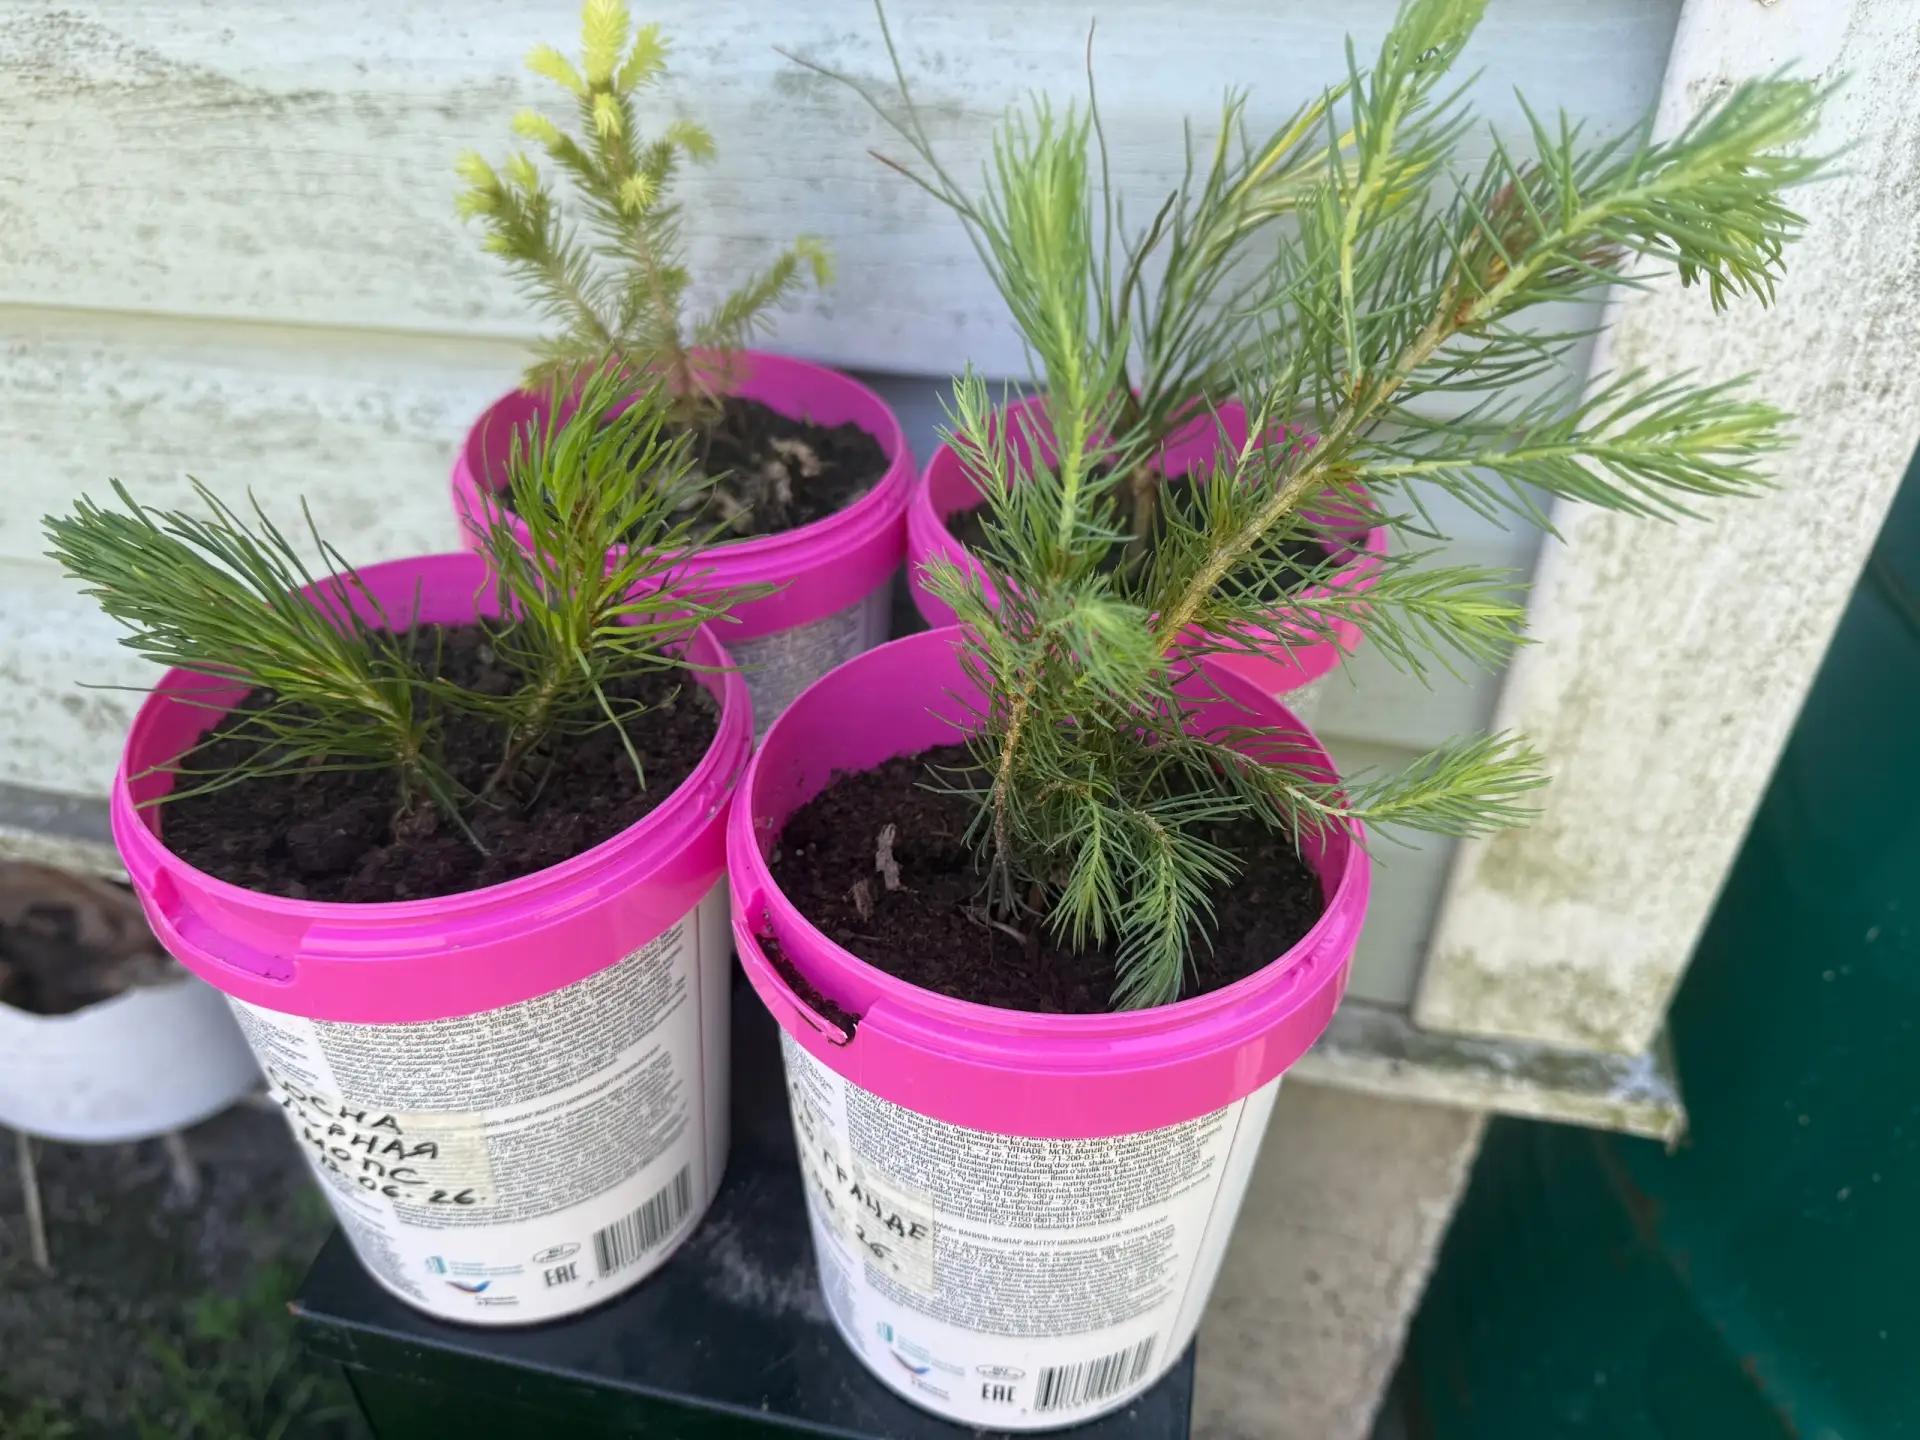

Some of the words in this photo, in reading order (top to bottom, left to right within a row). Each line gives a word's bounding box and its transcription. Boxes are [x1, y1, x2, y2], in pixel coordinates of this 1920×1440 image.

[952, 1127, 994, 1143] Ogorodniy
[966, 1138, 1001, 1150] korxona:
[1074, 1146, 1104, 1154] Manzil:
[981, 1381, 1017, 1403] EAC
